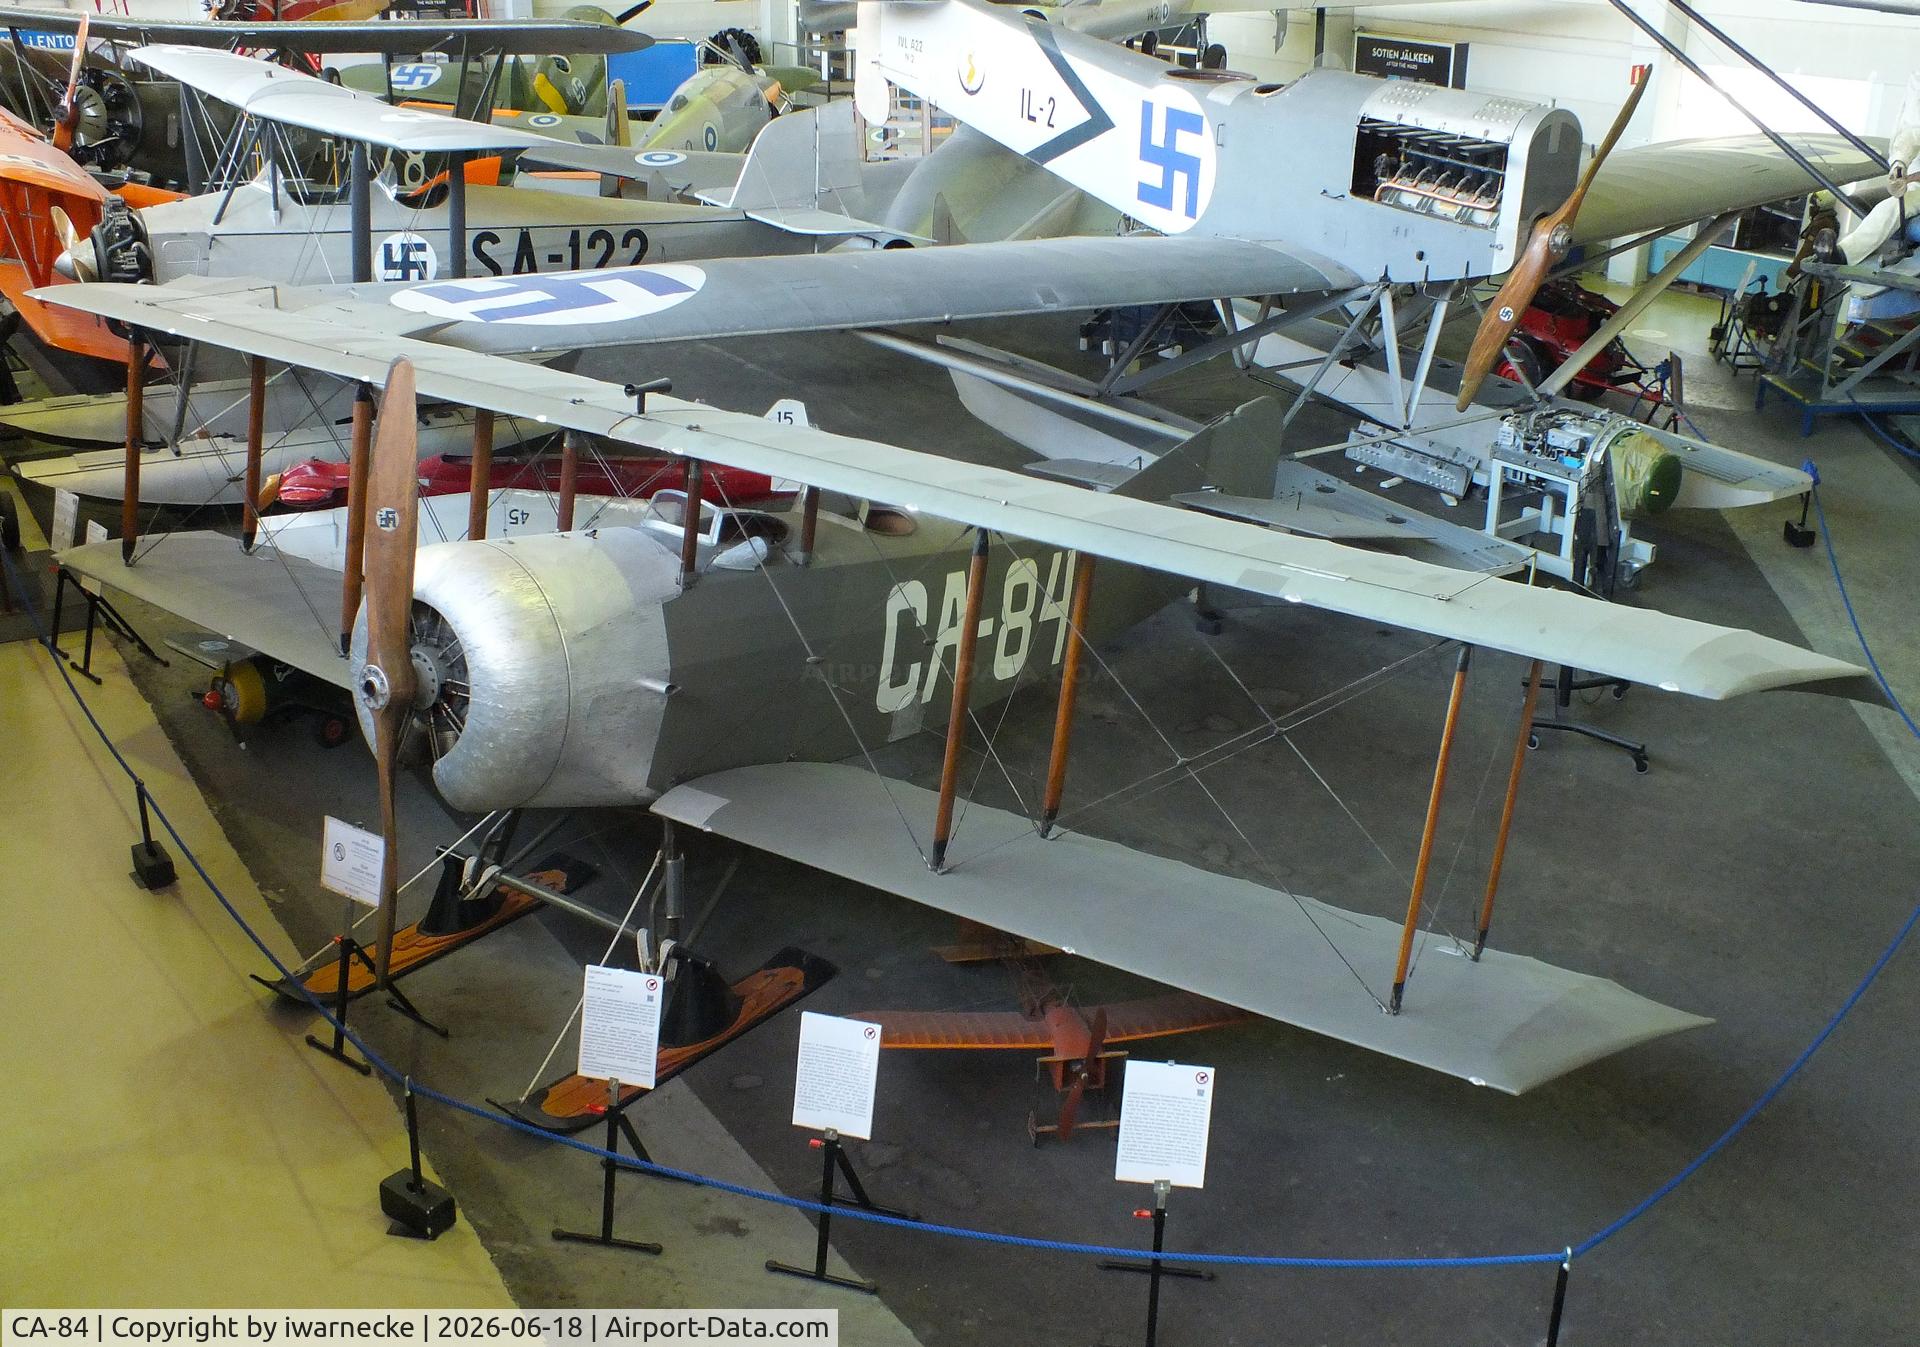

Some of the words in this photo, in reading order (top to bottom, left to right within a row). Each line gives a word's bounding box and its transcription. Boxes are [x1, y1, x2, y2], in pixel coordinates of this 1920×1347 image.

[1372, 48, 1399, 59] SOTIEN
[1400, 49, 1434, 64] JÄLKEEN
[1021, 87, 1056, 129] IL-2
[777, 411, 794, 425] 15
[509, 508, 530, 525] 45
[876, 549, 1077, 714] CA-84
